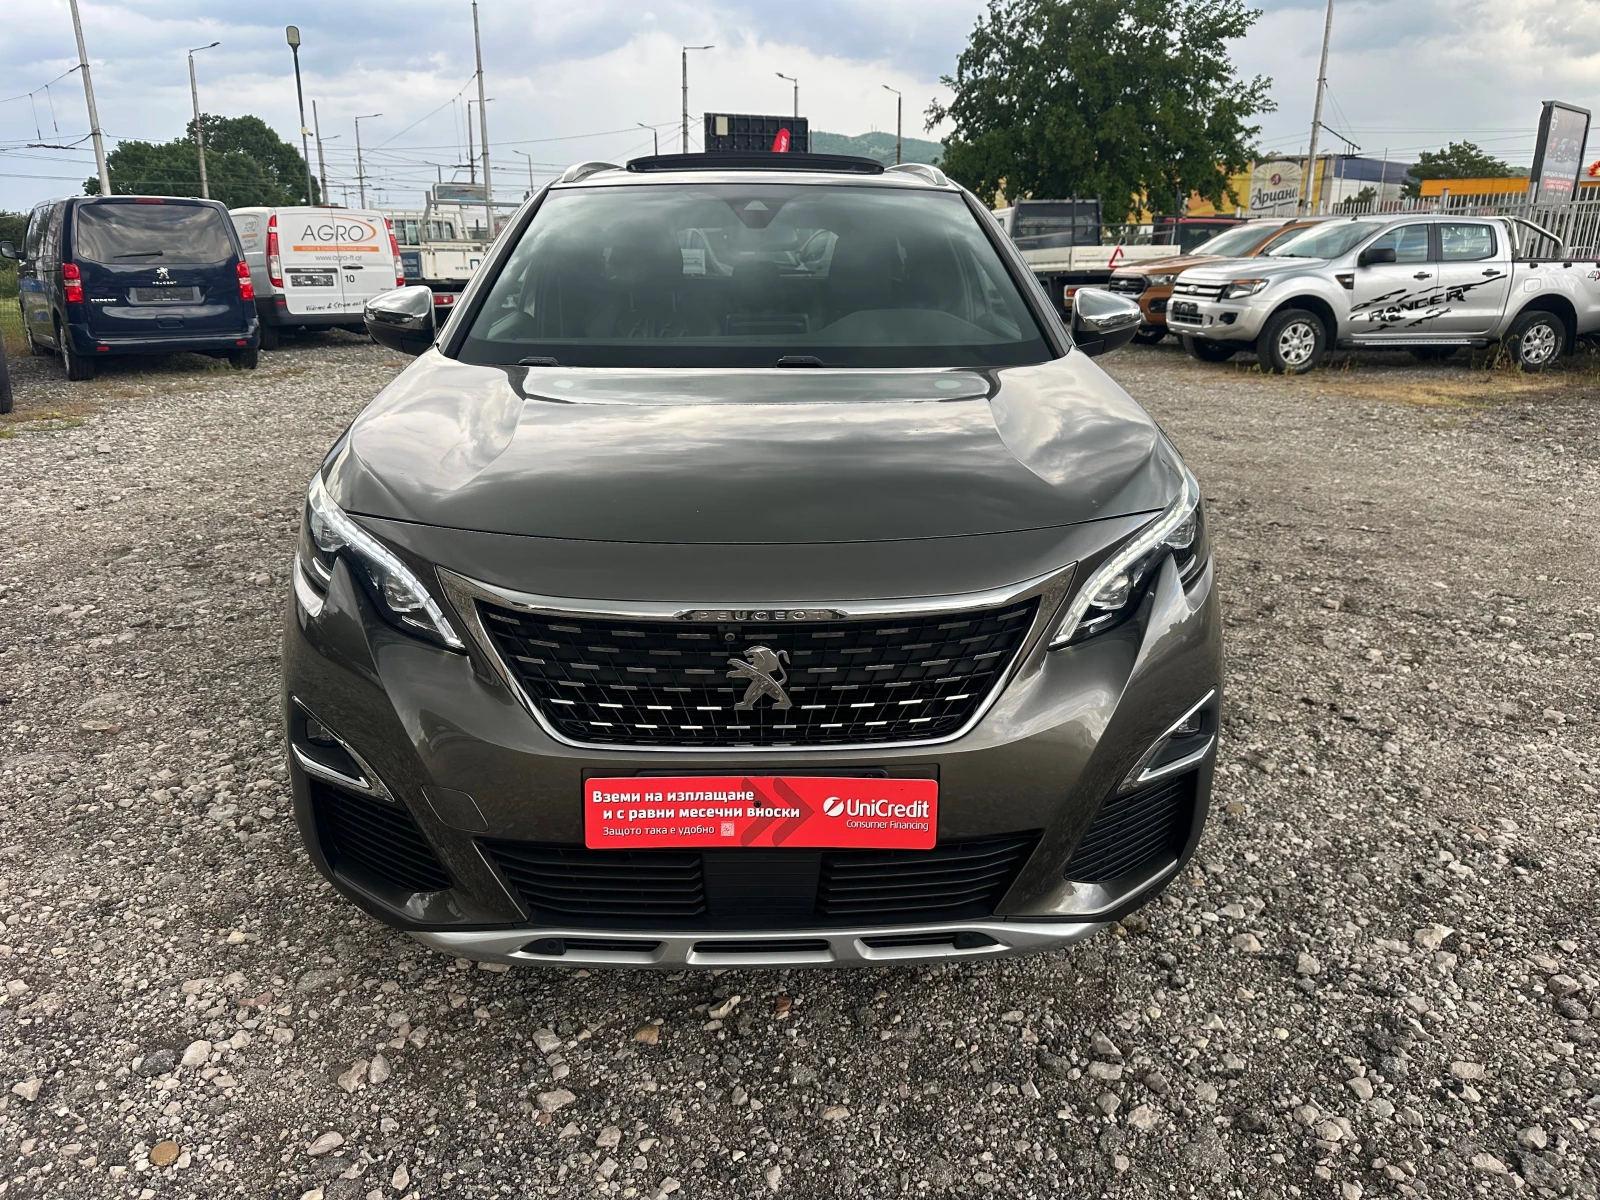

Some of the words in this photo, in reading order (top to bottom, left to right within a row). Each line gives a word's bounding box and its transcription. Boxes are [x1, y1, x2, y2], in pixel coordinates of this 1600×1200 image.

[301, 225, 364, 242] AGRO
[344, 274, 355, 283] 10
[1367, 288, 1466, 322] RANGER
[696, 610, 825, 621] PEUGEOT
[592, 791, 641, 803] Вземи
[645, 793, 663, 802] на
[667, 791, 755, 803] изплащане
[602, 809, 613, 819] и
[616, 809, 625, 819] с
[628, 809, 675, 821] равни
[679, 808, 743, 818] месечни
[747, 807, 800, 818] вноски
[846, 799, 930, 818] UniCredit
[602, 827, 642, 837] Защото
[644, 826, 667, 835] така
[670, 827, 676, 835] е
[679, 825, 715, 836] удобно
[846, 820, 888, 829] Consumer
[890, 820, 929, 832] Financing
